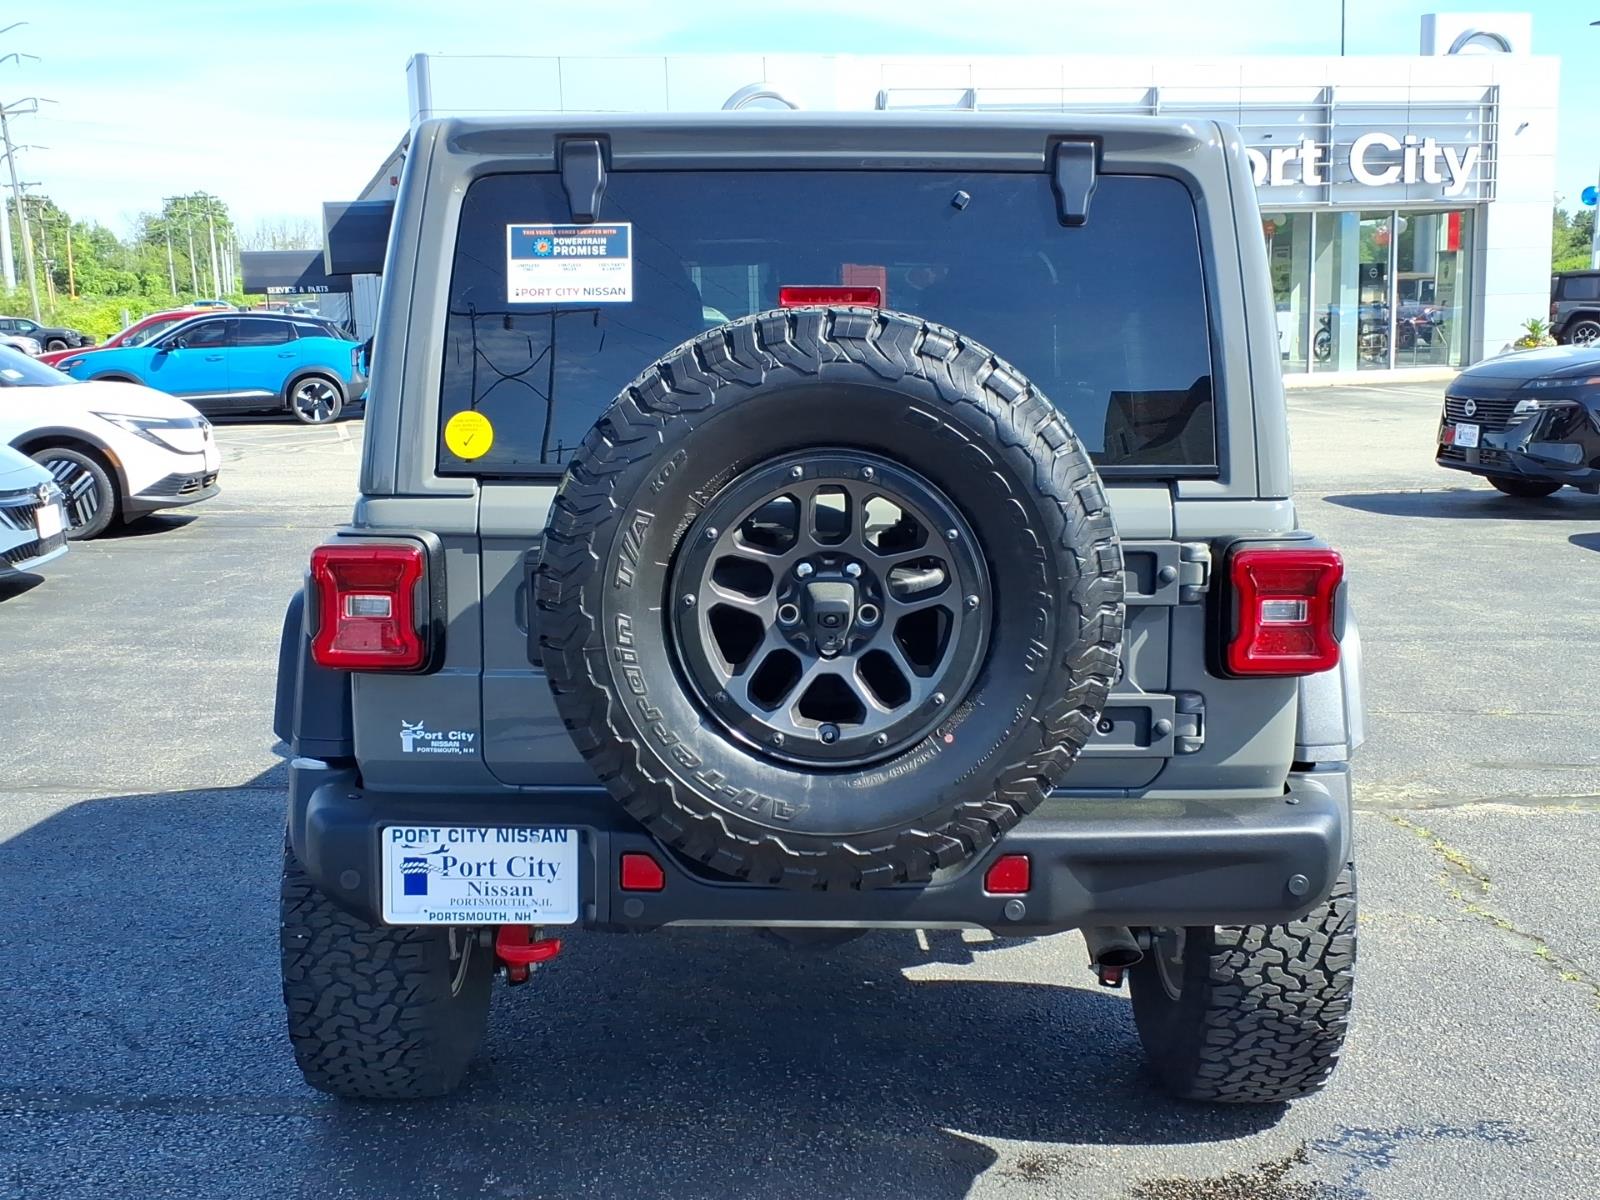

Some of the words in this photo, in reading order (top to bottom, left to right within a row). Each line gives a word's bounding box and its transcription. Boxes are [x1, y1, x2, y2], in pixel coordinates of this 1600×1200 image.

[1245, 138, 1322, 187] ort
[1349, 132, 1481, 197] City
[553, 237, 607, 246] POWERTRAIN
[553, 246, 607, 256] PROMISE
[267, 286, 297, 294] SERVICE
[521, 288, 552, 297] PORT
[555, 288, 580, 296] CITY
[583, 287, 626, 296] NISSAN
[416, 730, 443, 740] Port
[448, 730, 475, 742] City
[392, 829, 441, 843] PORT
[448, 829, 489, 843] CITY
[496, 829, 568, 843] NISSAN
[440, 855, 498, 877] Port
[506, 856, 561, 884] City
[467, 881, 534, 897] Nissan
[450, 898, 529, 908] PORTSMOUTH,
[429, 911, 511, 922] PORTSMOUTH,
[515, 911, 532, 921] NH
